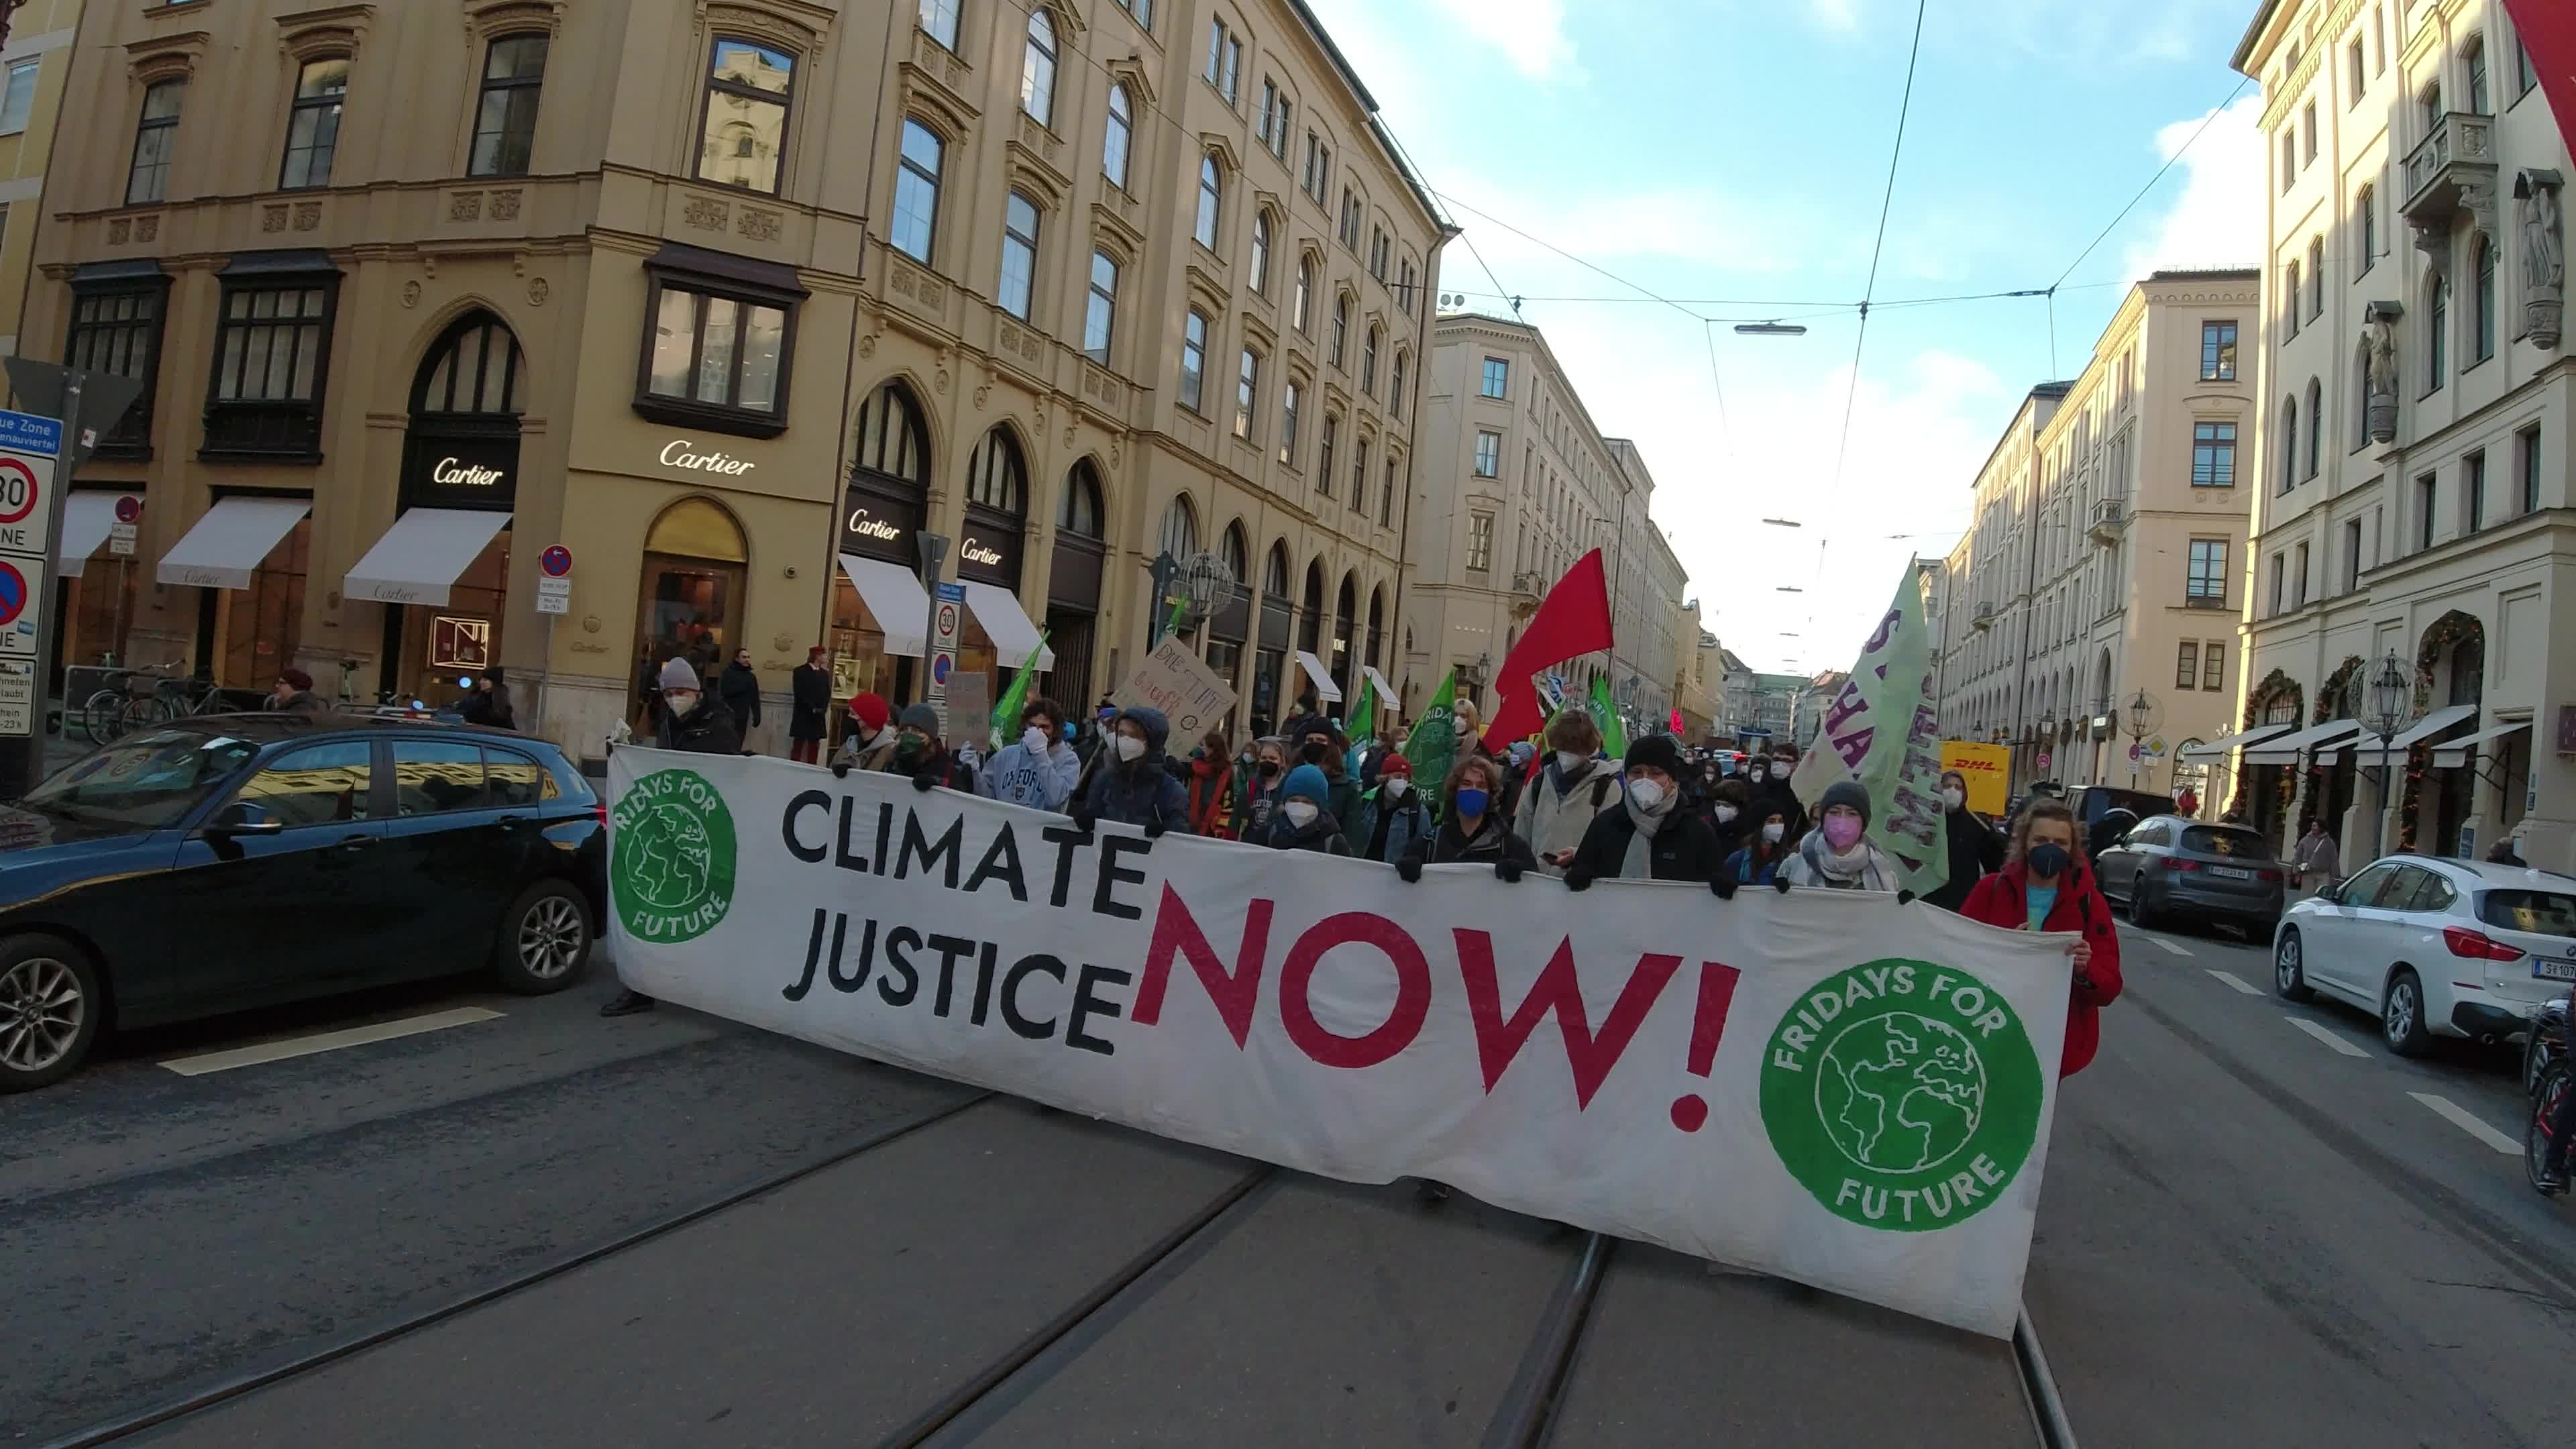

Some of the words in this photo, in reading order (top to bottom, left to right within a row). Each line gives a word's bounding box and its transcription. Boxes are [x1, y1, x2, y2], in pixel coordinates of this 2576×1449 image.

[20, 419, 50, 435] Zone
[433, 457, 502, 486] Cartier
[659, 439, 755, 476] Cartier
[849, 508, 900, 540] Cartier
[961, 537, 1002, 566] Cartier
[184, 569, 221, 586] Cartier
[374, 585, 419, 602] Cartier
[941, 614, 953, 627] 30
[1155, 643, 1185, 672] DIE
[1953, 759, 1996, 771] DHL
[615, 773, 673, 831] RIDAYS
[679, 776, 717, 816] FOR
[782, 790, 1152, 920] CLIMATE
[633, 890, 727, 936] FUTURE
[782, 908, 1132, 1056] JUSTICE
[2559, 965, 2576, 977] 107
[1130, 877, 1741, 1133] NOW!
[1774, 965, 1917, 1072] FRIDAYS
[1928, 974, 2008, 1038] FOR
[1835, 1152, 2006, 1222] FUTURE
